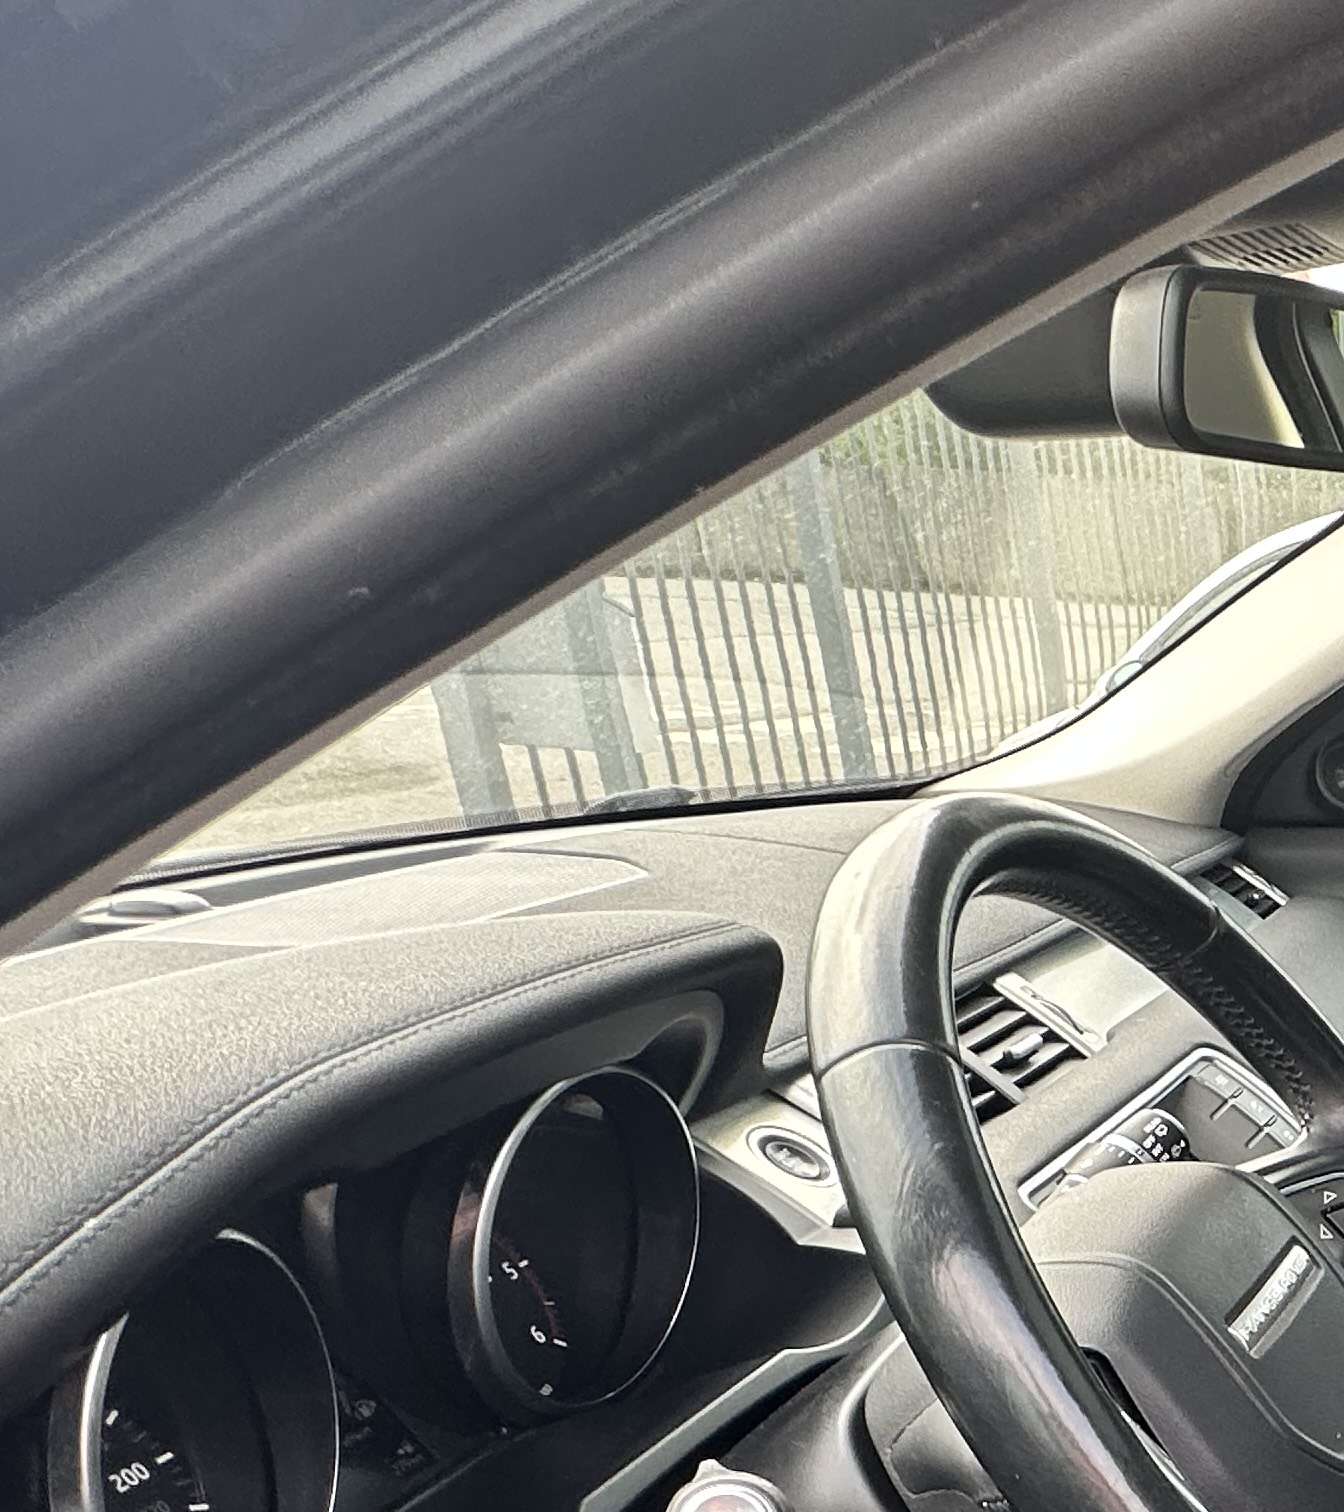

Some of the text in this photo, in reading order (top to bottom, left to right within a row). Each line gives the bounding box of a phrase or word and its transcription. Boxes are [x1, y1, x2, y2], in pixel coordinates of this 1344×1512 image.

[501, 1261, 519, 1280] 5
[530, 1325, 546, 1344] 6
[108, 1461, 150, 1493] 200
